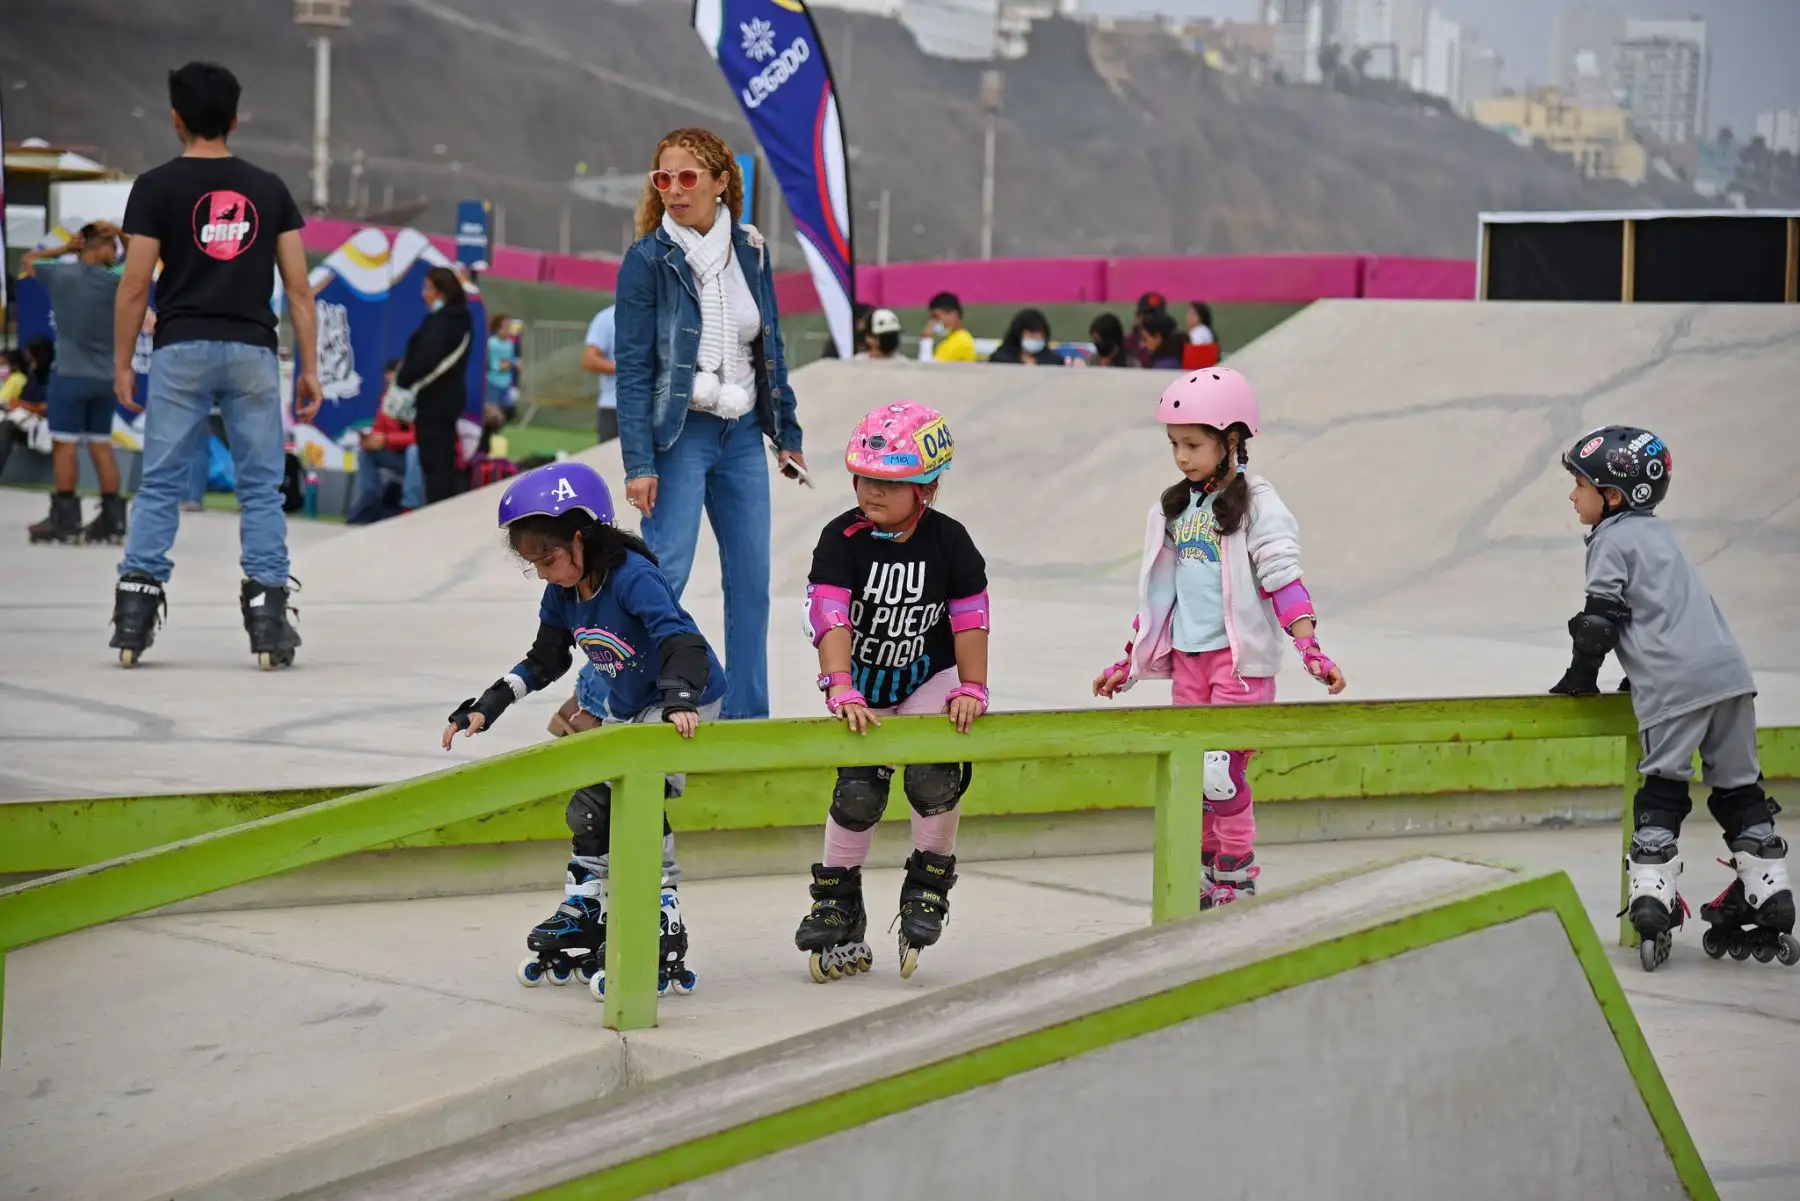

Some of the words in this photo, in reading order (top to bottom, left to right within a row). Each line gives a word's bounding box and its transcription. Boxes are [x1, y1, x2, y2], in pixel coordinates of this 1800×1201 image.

[923, 423, 953, 459] 048
[551, 477, 579, 503] A
[1172, 511, 1222, 546] SUPE
[862, 561, 926, 605] HOY
[851, 600, 865, 626] O
